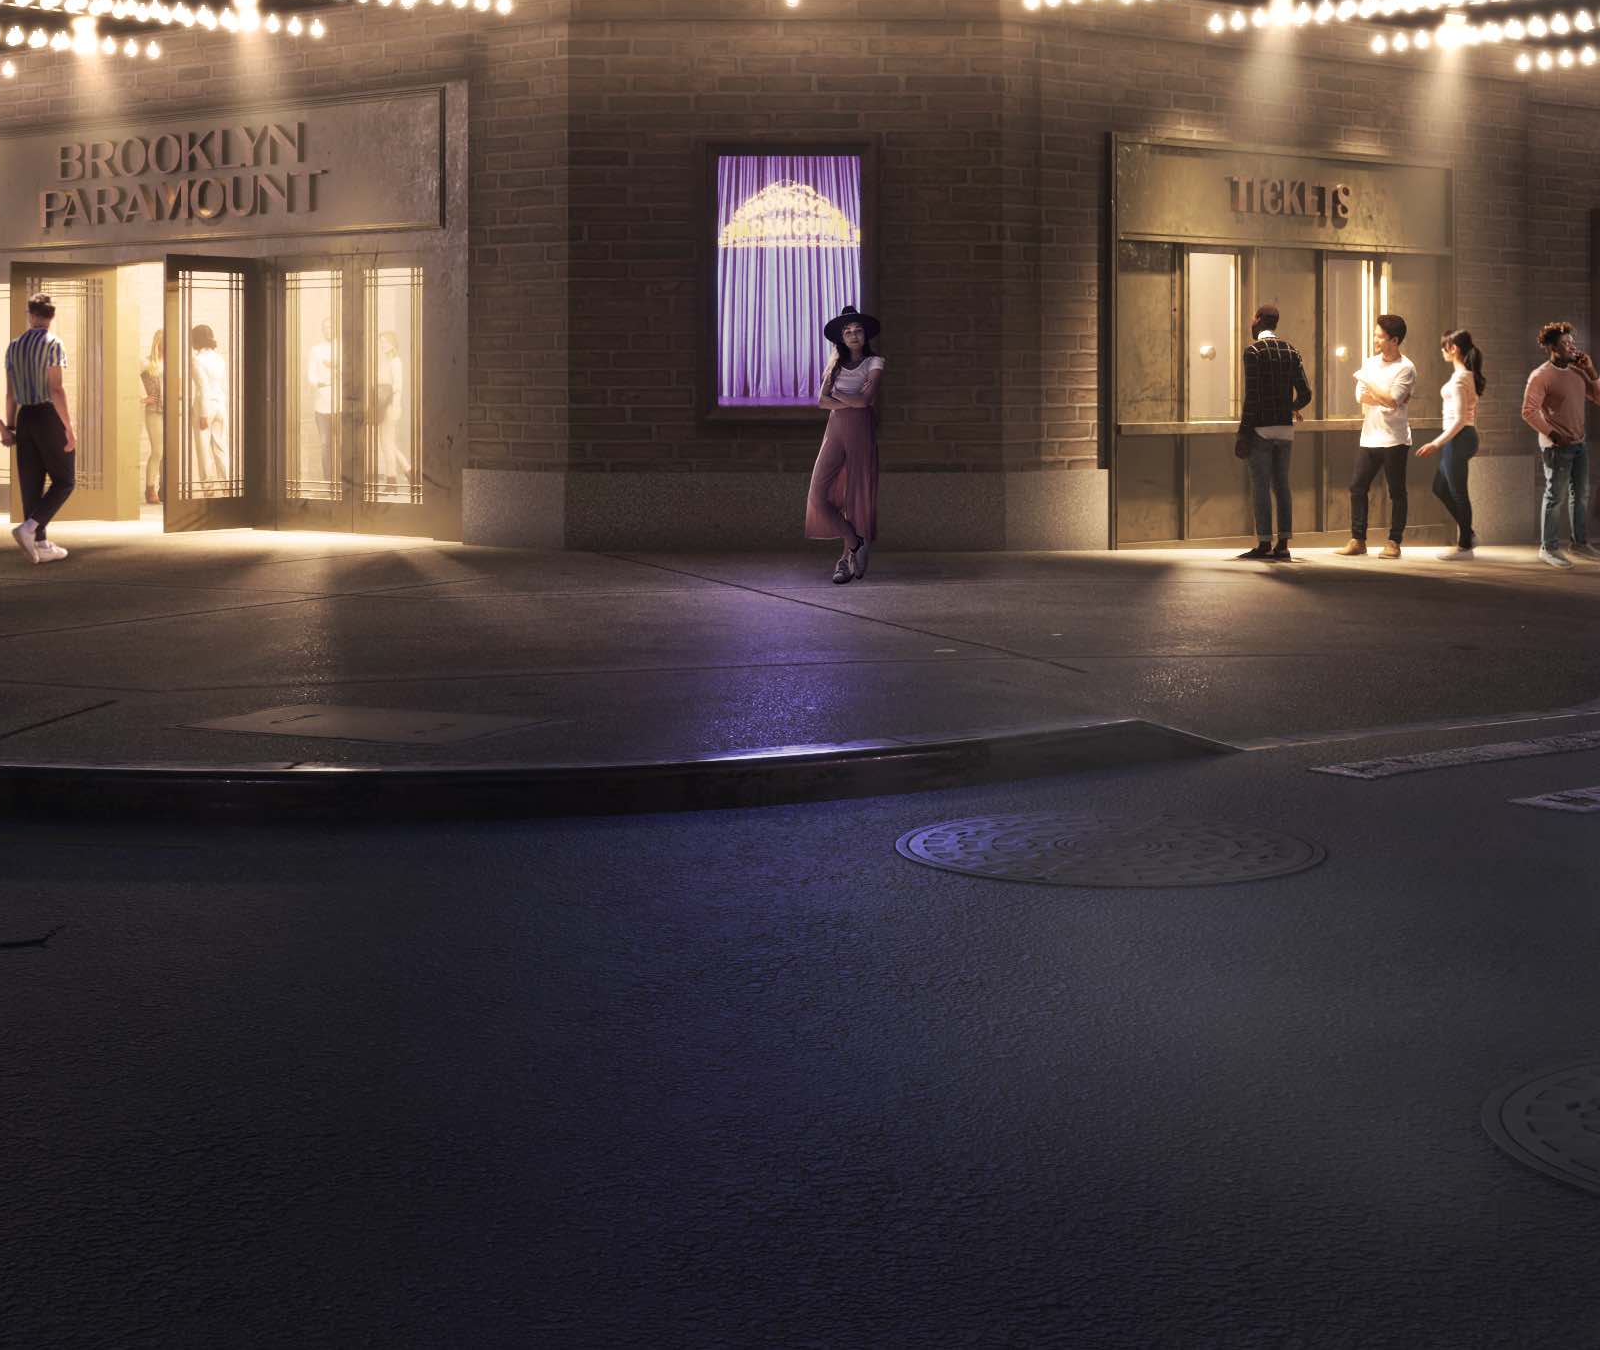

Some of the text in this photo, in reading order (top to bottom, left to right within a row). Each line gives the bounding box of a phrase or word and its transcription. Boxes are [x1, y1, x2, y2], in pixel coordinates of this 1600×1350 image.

[56, 121, 306, 182] BROOKLYN
[39, 169, 328, 229] PARAMOUNT
[1229, 176, 1353, 219] TICKETS
